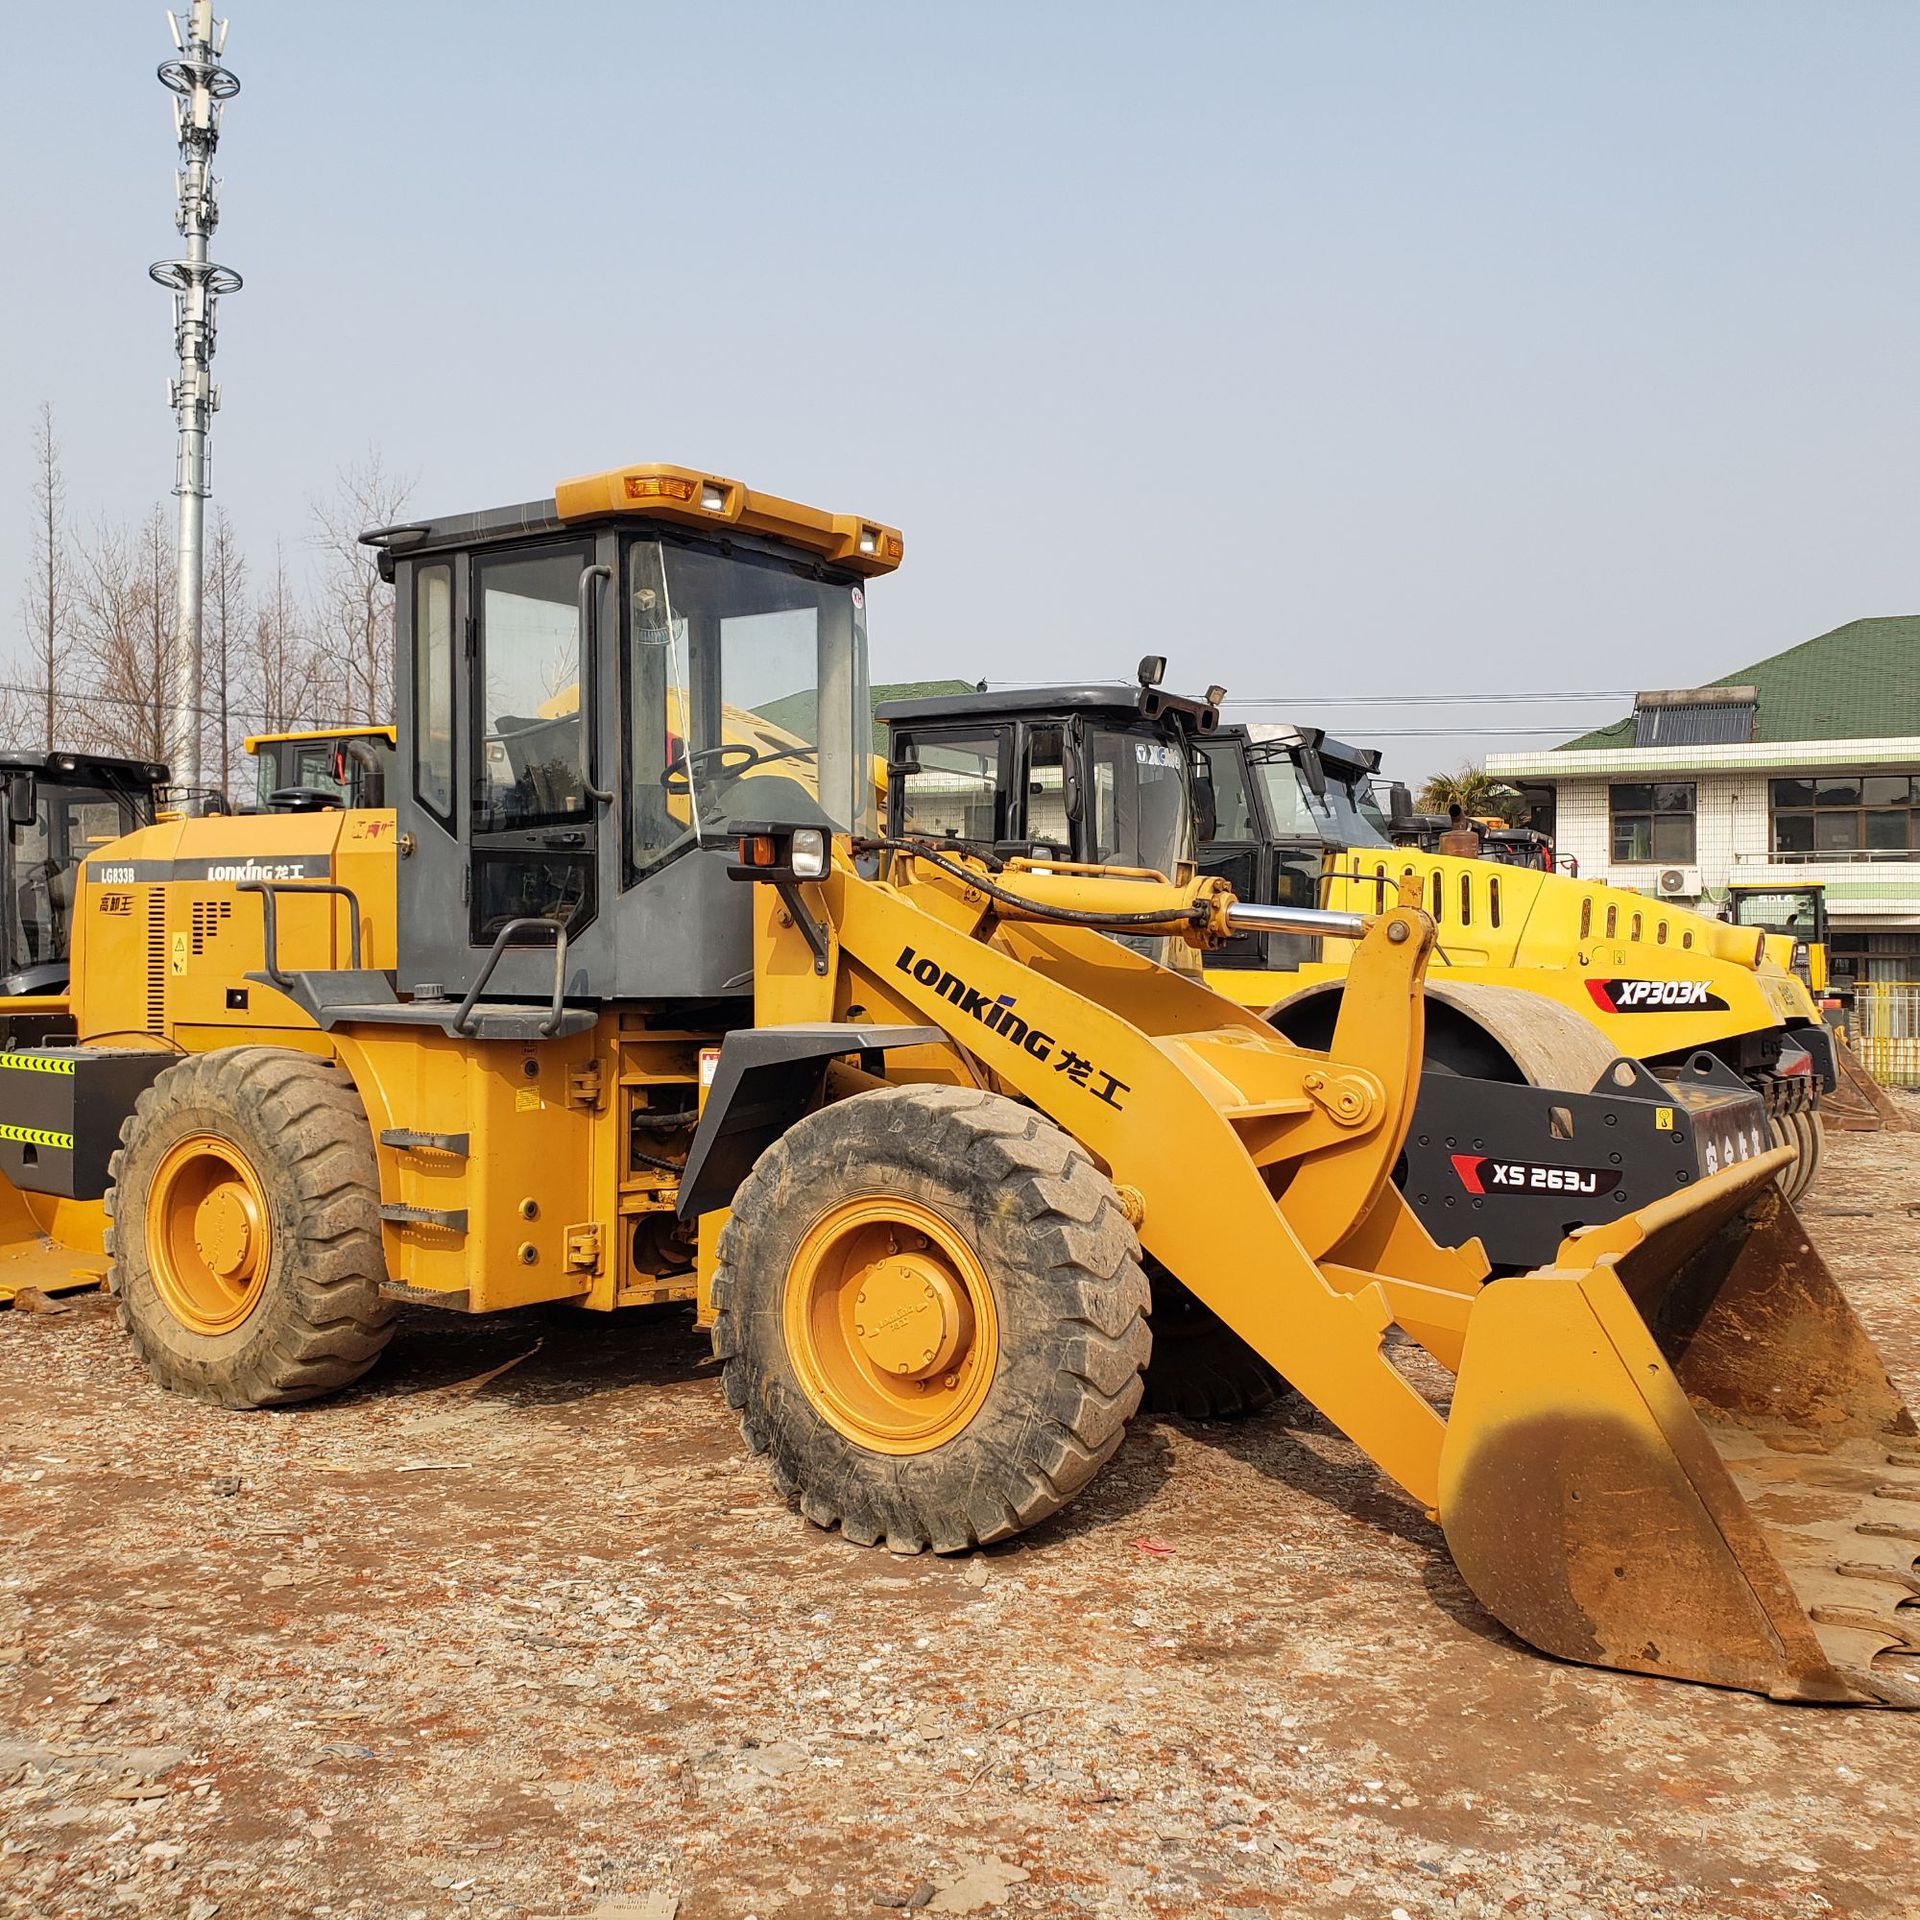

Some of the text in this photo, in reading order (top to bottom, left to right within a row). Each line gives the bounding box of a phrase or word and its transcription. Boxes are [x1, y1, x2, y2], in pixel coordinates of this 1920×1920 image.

[101, 867, 135, 883] LG833B
[1616, 979, 1713, 1005] XP303K
[1053, 1048, 1131, 1112] 龙工
[1492, 1164, 1597, 1193] XS 263J
